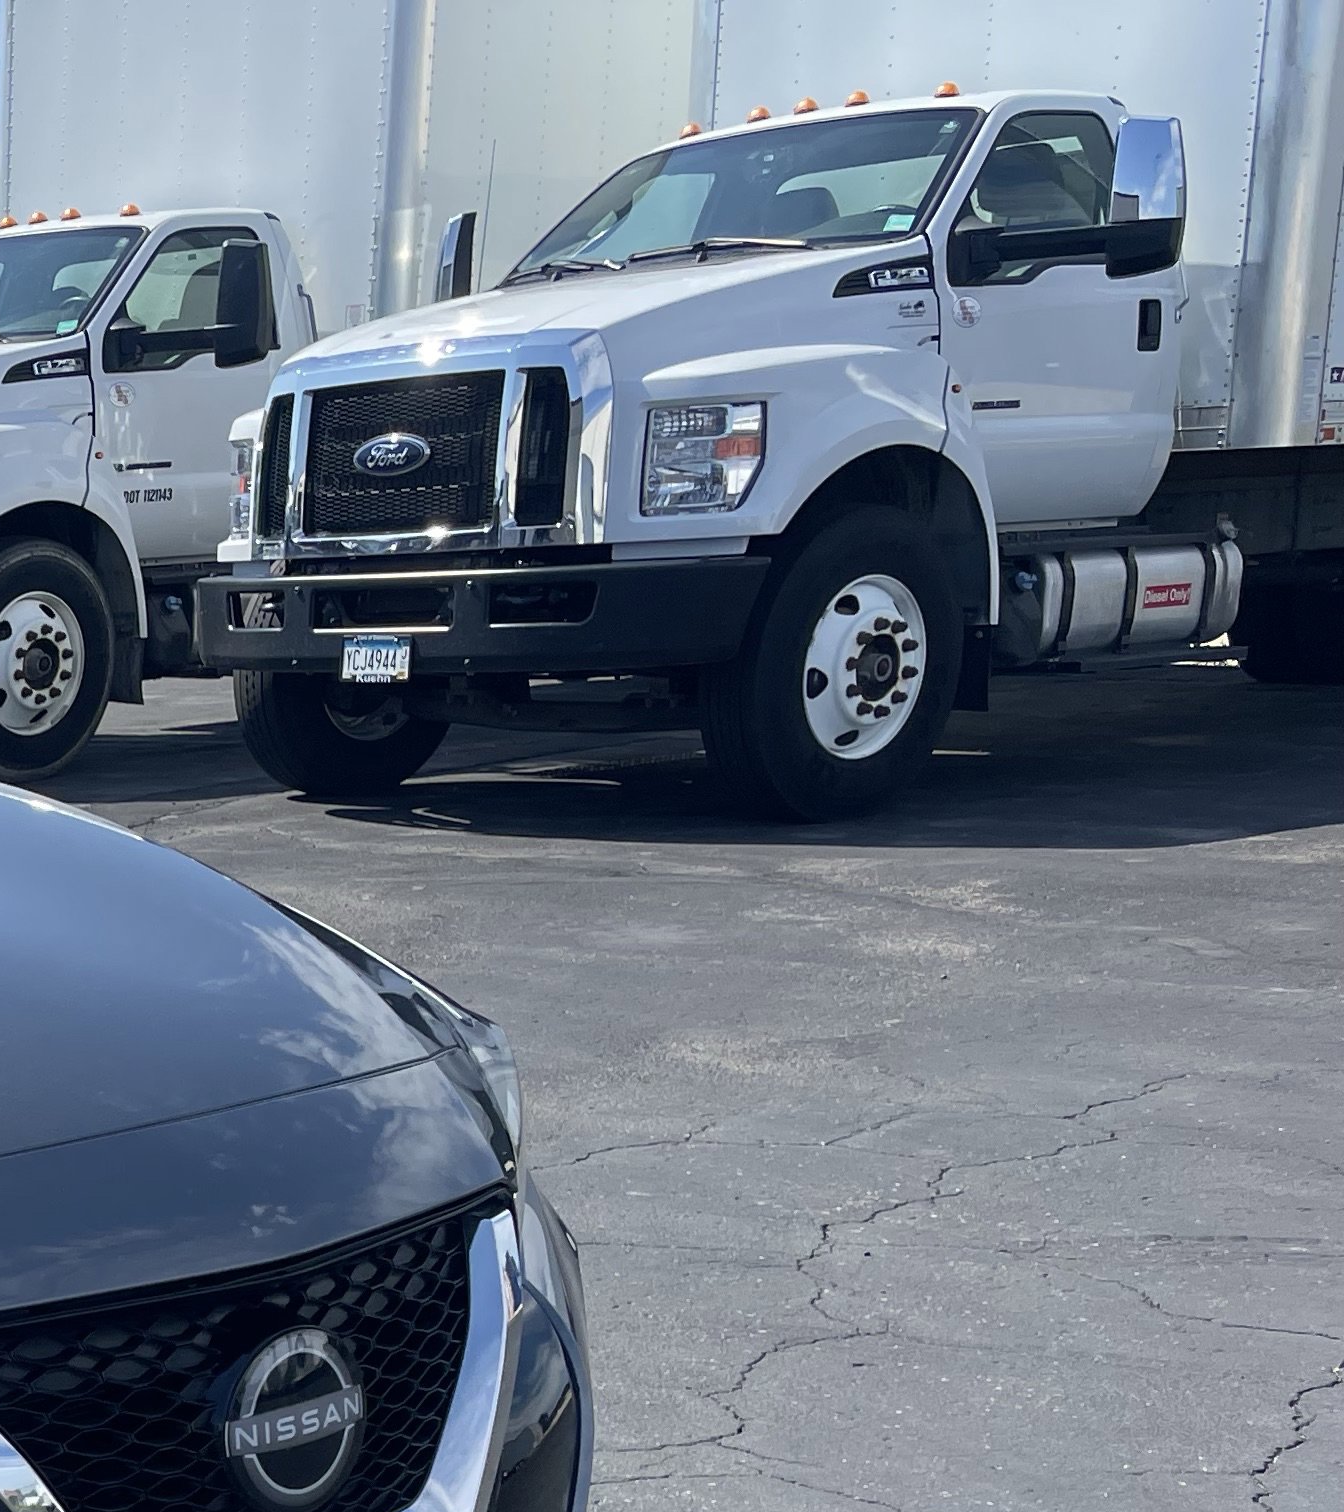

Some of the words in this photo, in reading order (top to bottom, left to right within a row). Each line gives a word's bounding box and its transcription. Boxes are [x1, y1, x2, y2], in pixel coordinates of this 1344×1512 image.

[366, 443, 409, 468] Ford
[1145, 589, 1169, 604] Diesel
[1170, 587, 1191, 603] Only!
[346, 649, 397, 671] YCJ4944
[235, 1393, 360, 1450] NISSAN
